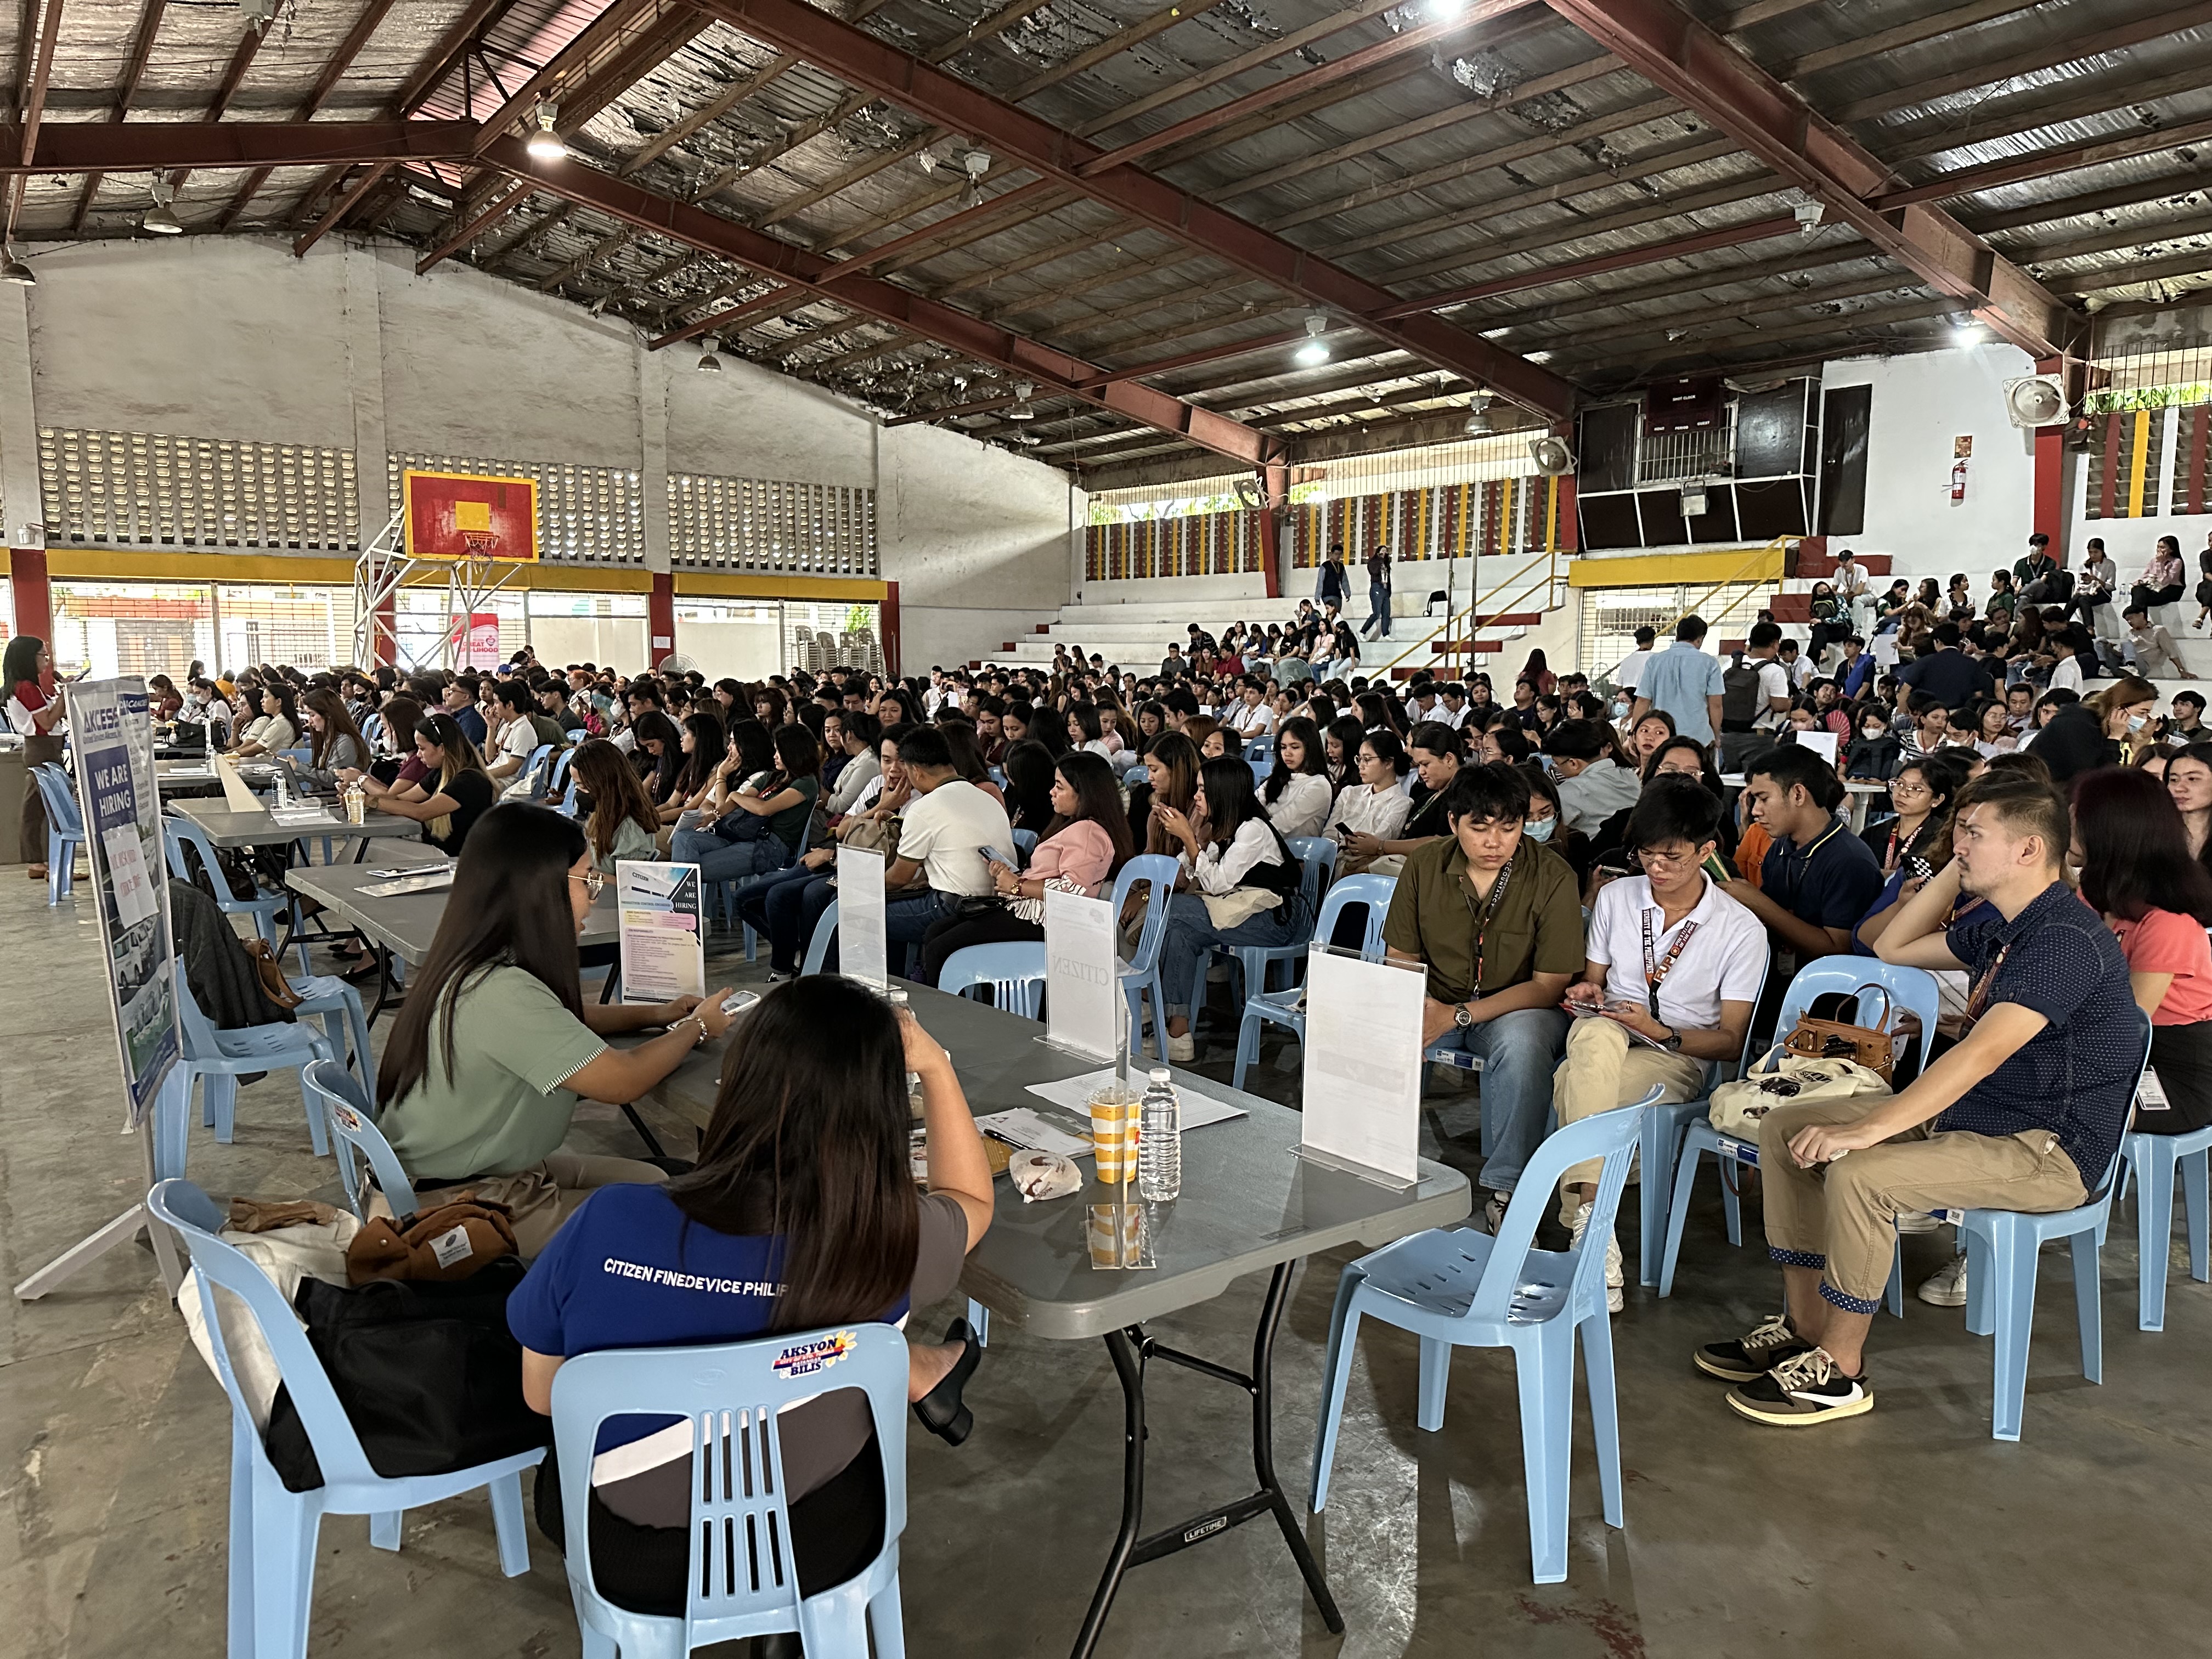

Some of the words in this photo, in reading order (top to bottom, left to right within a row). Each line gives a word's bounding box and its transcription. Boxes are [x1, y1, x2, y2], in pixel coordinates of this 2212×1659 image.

[84, 707, 120, 733] AKCESS
[94, 769, 110, 790] WE
[111, 764, 128, 786] ARE
[99, 789, 131, 817] HIRING
[632, 872, 648, 882] CITIZEN
[1656, 956, 1673, 981] PUP
[604, 1259, 653, 1281] CITIZEN
[653, 1269, 742, 1294] FINEDEVICE
[781, 1338, 838, 1359] AKSYON
[791, 1362, 821, 1376] BILIS
[1189, 1520, 1222, 1538] LIFETIME
